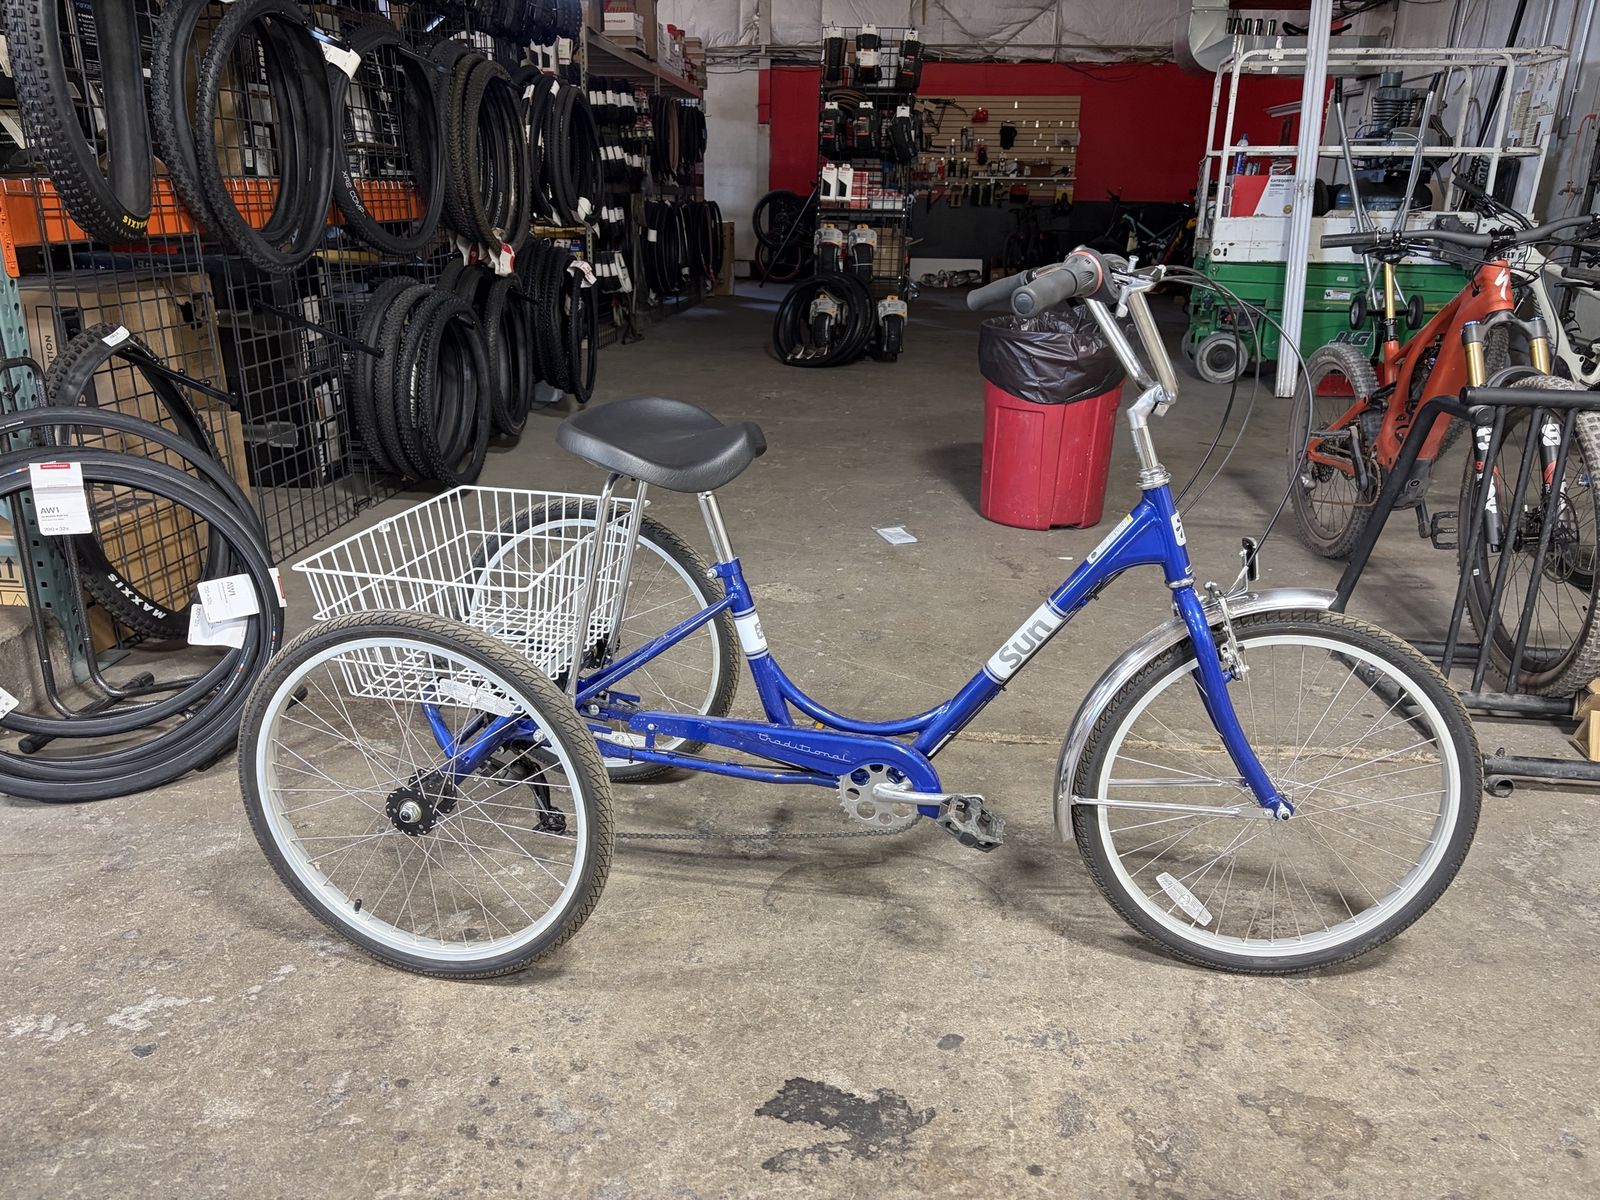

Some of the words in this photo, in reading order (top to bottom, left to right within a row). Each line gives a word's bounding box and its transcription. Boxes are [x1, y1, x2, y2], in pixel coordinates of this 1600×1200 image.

[349, 190, 365, 213] COMP
[41, 506, 60, 515] AW1
[107, 573, 168, 620] MAXXIS
[757, 732, 852, 764] traditional
